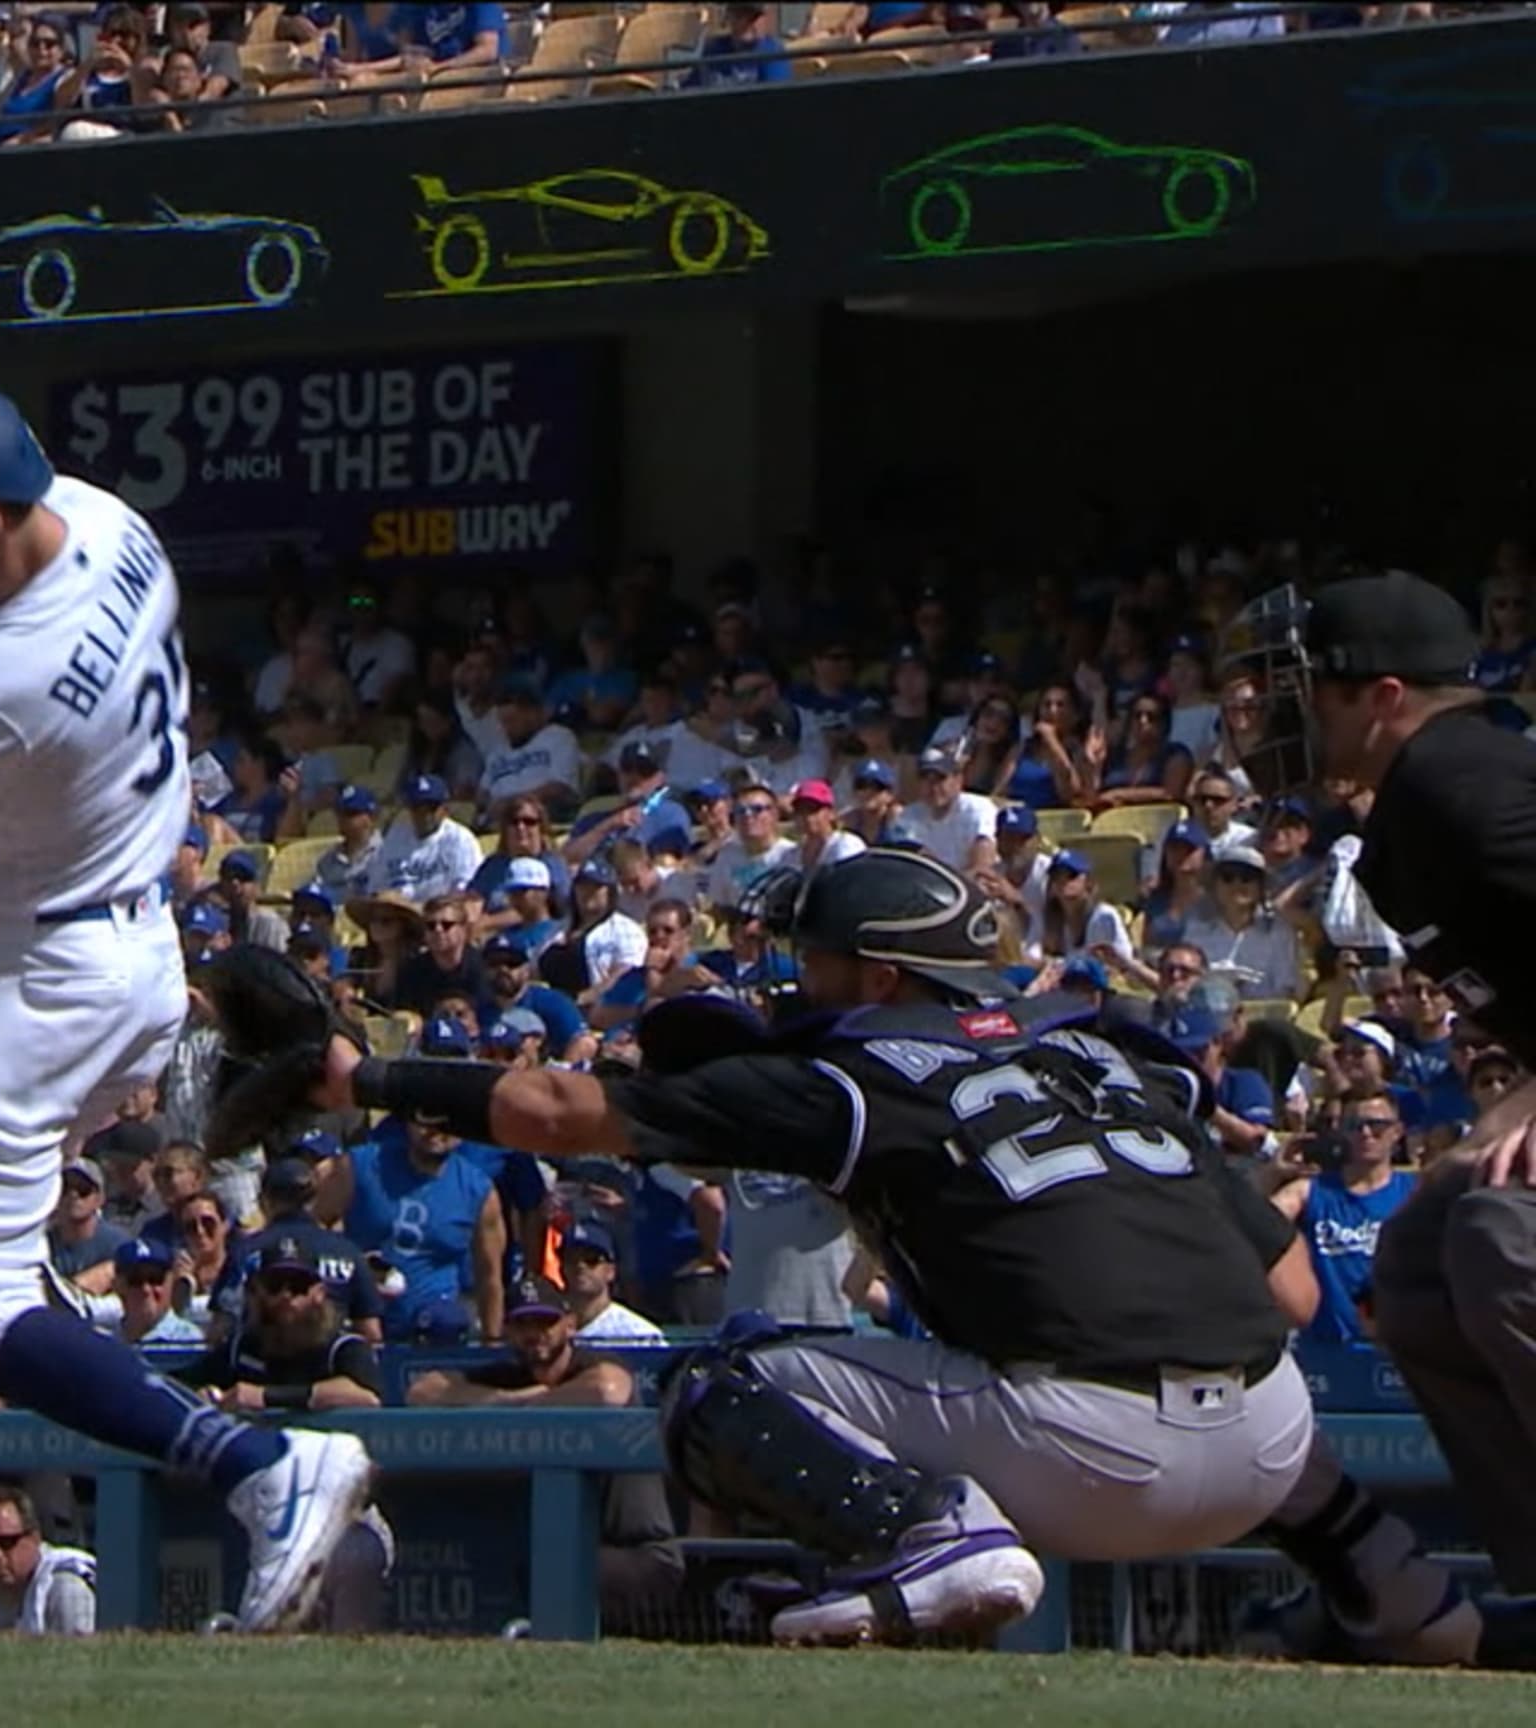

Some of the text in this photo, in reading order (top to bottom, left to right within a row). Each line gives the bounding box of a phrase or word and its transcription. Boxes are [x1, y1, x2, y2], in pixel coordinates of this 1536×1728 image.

[300, 362, 512, 431] SUB OF
[201, 456, 281, 481] 6-INCH
[297, 424, 541, 493] THE DAY
[366, 503, 569, 558] SUBWAY
[49, 514, 162, 718] BELLING
[1315, 1218, 1383, 1256] Dodg
[421, 1431, 451, 1454] OF
[464, 1430, 595, 1454] AMERICA
[1334, 1435, 1441, 1462] ERICA
[397, 1576, 473, 1620] IELD
